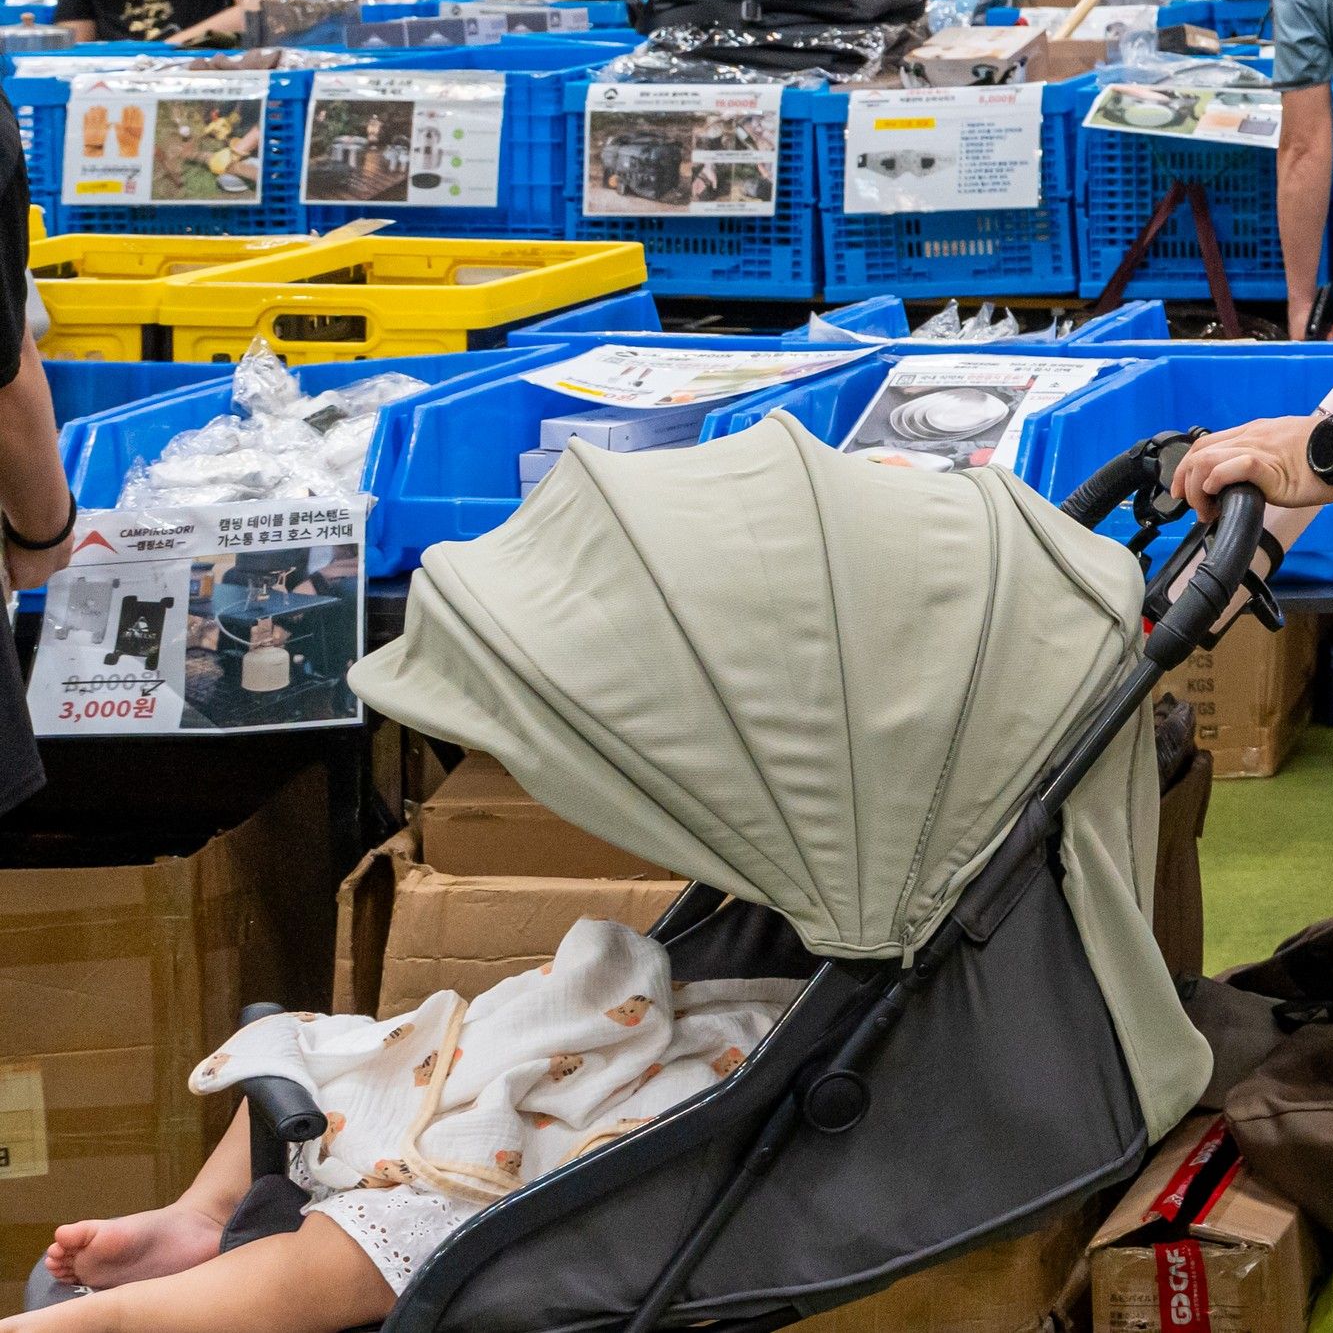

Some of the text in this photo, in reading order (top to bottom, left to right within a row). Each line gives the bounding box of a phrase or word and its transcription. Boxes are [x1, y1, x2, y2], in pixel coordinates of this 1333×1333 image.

[247, 513, 285, 528] 테이블
[217, 524, 354, 548] 가스통 후크 호스 거치대
[58, 696, 157, 723] 3,000원
